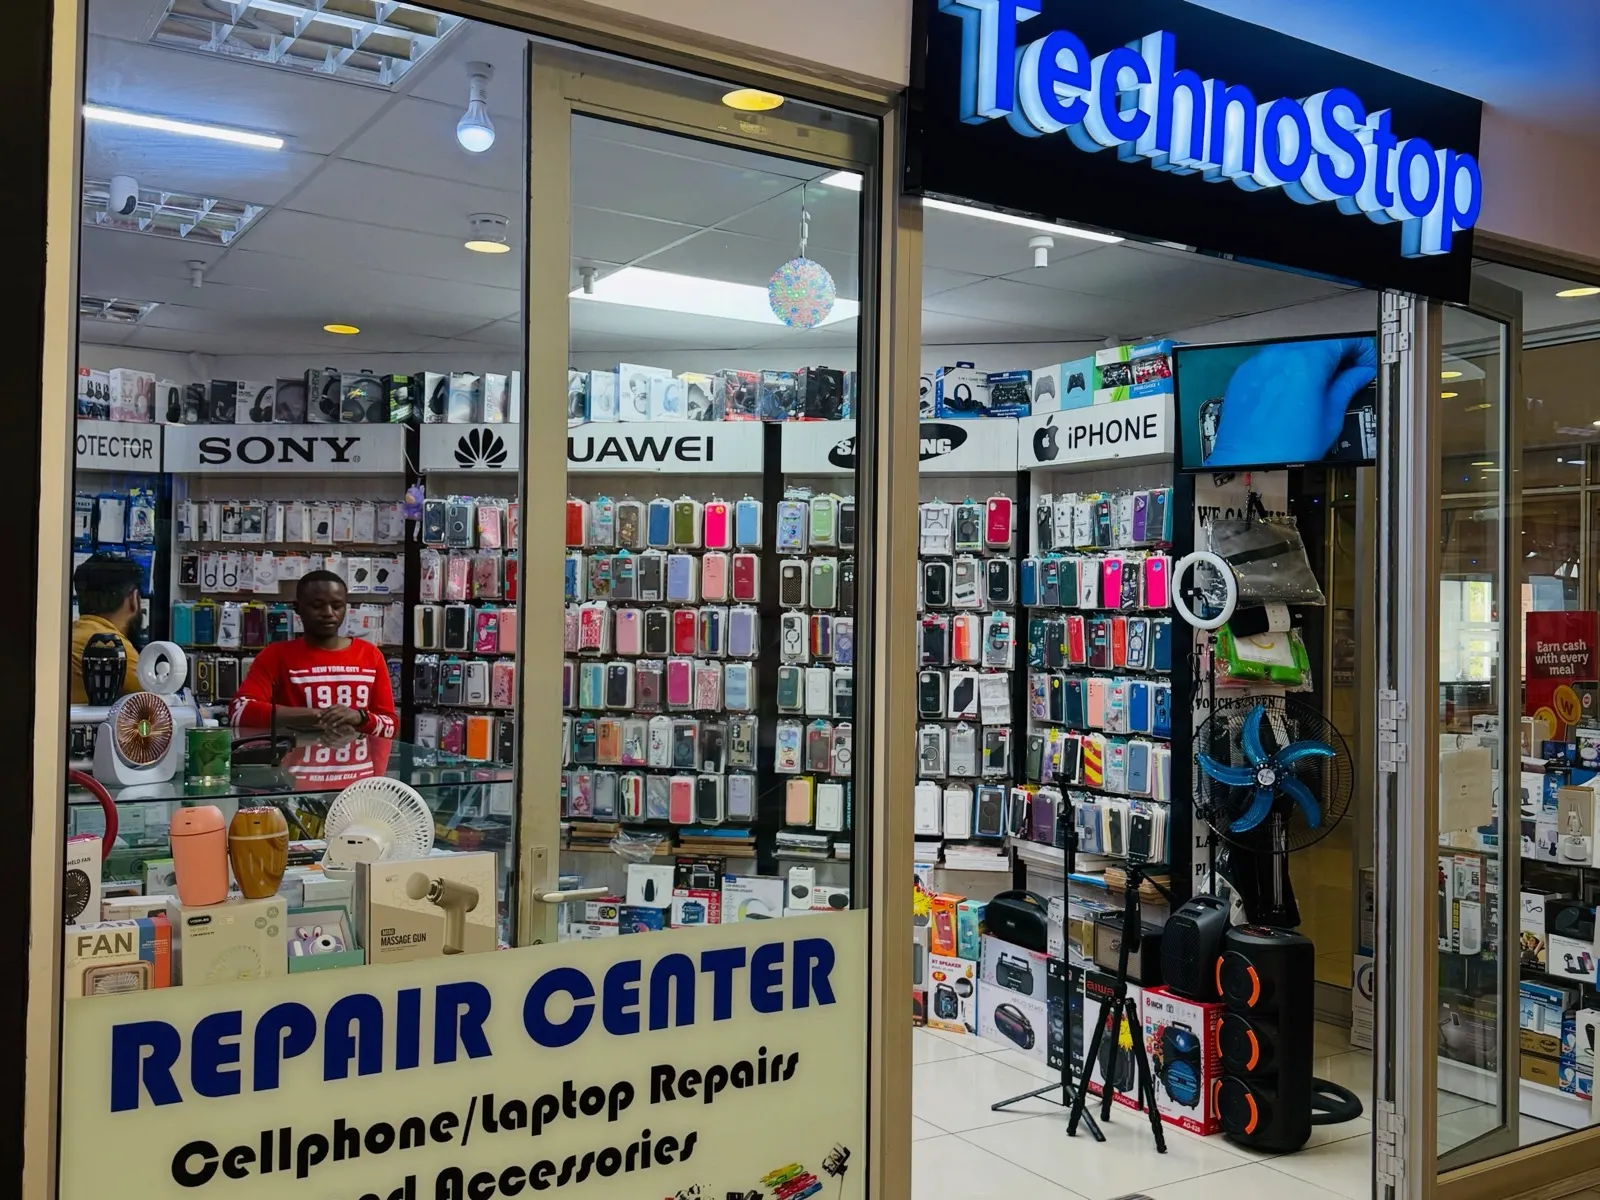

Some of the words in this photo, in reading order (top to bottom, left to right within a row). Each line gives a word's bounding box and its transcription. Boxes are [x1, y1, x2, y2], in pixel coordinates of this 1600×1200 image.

[940, 0, 1481, 258] TechnoStop
[1068, 413, 1158, 449] iPHONE
[76, 434, 152, 459] OTECTOR
[199, 437, 360, 464] SONY
[567, 437, 714, 462] UAWEI
[1535, 652, 1558, 665] with
[1560, 653, 1589, 665] every
[1537, 641, 1560, 653] Earn
[1562, 639, 1587, 651] cash
[1549, 663, 1575, 676] meal
[304, 685, 369, 709] 1989
[77, 932, 133, 957] FAN
[381, 934, 412, 947] MASSAGE
[412, 933, 427, 943] GUN
[1086, 980, 1115, 997] aiwa
[1146, 998, 1150, 1007] 8
[1150, 1000, 1163, 1011] INCH
[111, 981, 493, 1112] REPAIR
[523, 938, 836, 1047] CENTER
[172, 1080, 635, 1188] Cellphone/Laptop
[651, 1048, 799, 1105] Repairs
[436, 1130, 697, 1200] Accessories
